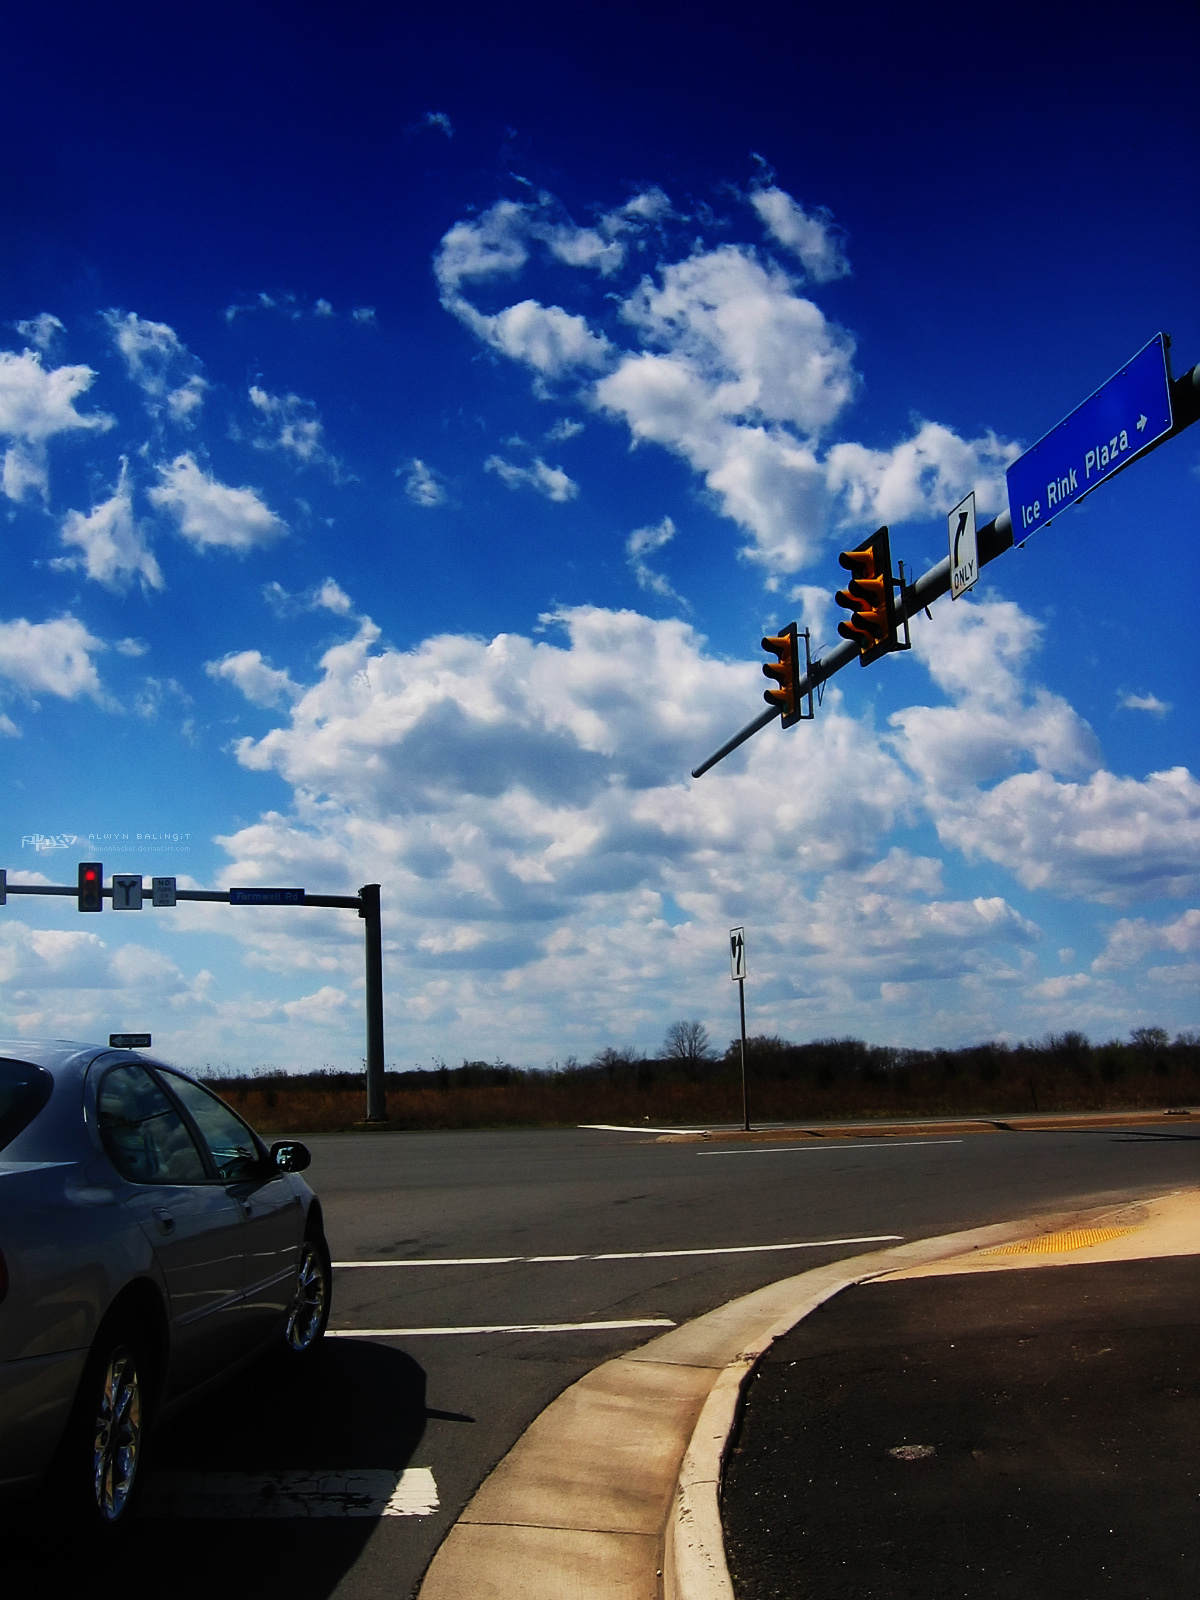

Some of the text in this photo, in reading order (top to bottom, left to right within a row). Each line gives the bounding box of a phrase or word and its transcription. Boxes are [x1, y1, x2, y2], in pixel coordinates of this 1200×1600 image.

[1022, 429, 1129, 528] Ice Rink Plaza
[954, 559, 974, 590] ONLY
[236, 892, 298, 901] Farmwell Rd
